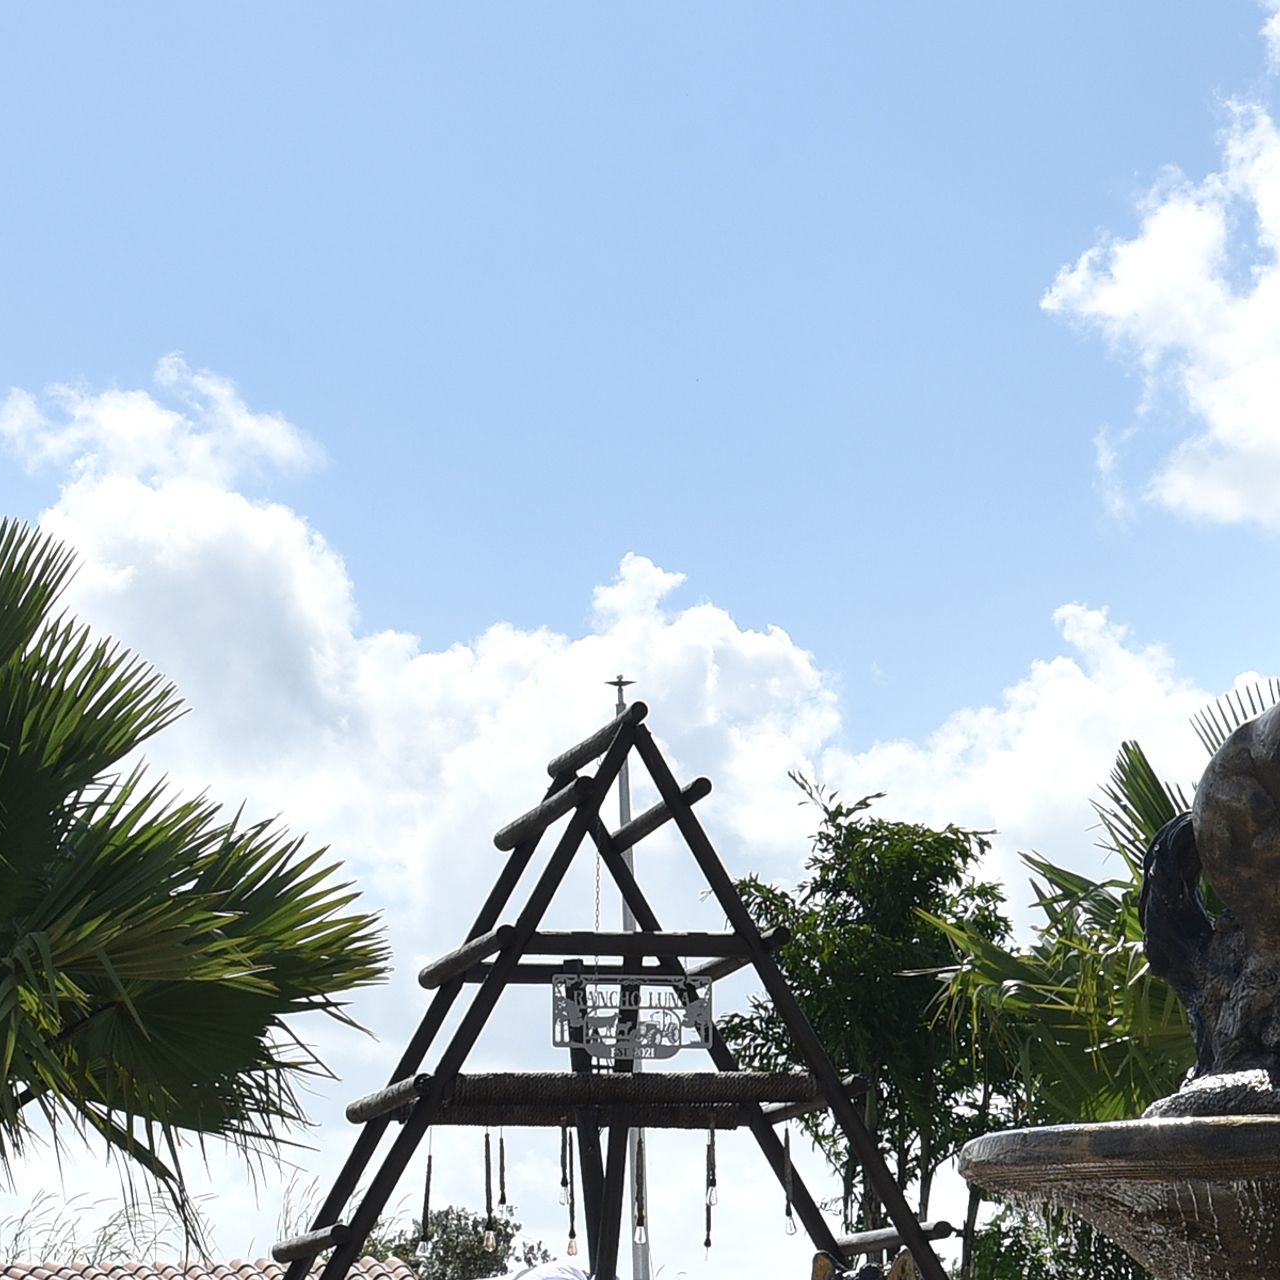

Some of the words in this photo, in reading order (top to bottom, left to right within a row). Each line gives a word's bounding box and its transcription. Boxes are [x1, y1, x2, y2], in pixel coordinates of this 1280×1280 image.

[574, 990, 640, 1008] RANCHO
[649, 991, 690, 1008] LUNA
[634, 1047, 655, 1057] 2021
